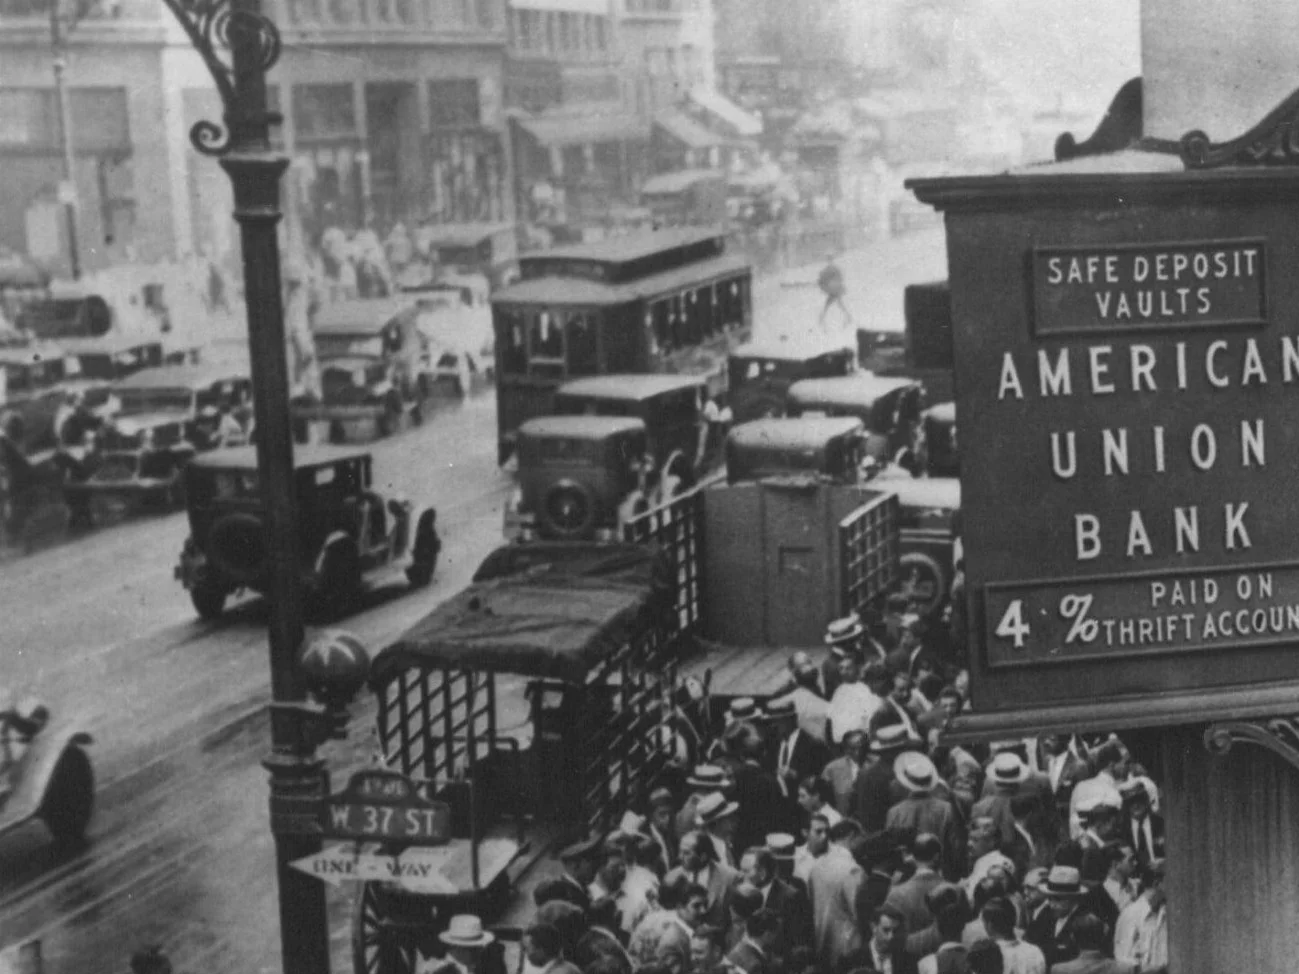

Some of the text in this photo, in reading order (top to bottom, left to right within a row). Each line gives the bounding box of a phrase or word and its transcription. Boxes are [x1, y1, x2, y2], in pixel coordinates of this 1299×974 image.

[1047, 249, 1258, 284] SAFE DEPOSIT
[1096, 288, 1211, 318] VAULTS
[1051, 419, 1266, 478] UNION
[1074, 502, 1252, 560] BANK
[1151, 573, 1274, 606] PAID ON
[1104, 614, 1195, 646] THRIFT
[363, 806, 394, 833] 37
